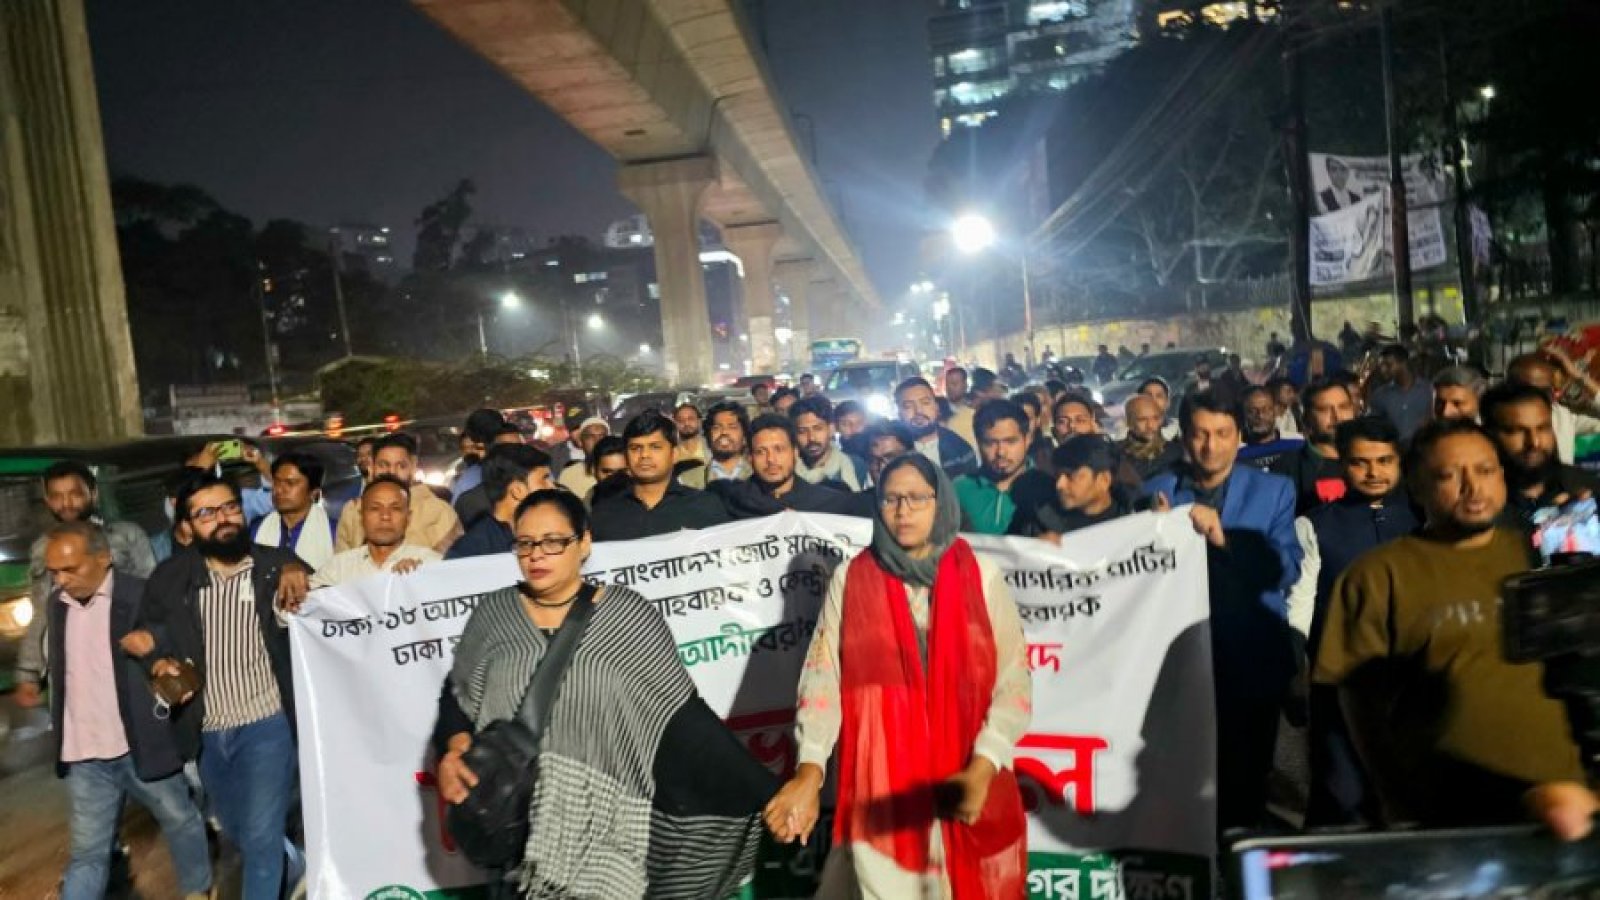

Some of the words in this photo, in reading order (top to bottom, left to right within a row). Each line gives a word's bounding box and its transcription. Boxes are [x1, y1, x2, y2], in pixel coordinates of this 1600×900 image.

[611, 549, 723, 587] বাংলাদেশ
[1106, 540, 1177, 577] পার্টির
[757, 577, 774, 598] ও
[322, 616, 374, 638] ঢাকা
[391, 638, 443, 666] ঢাকা
